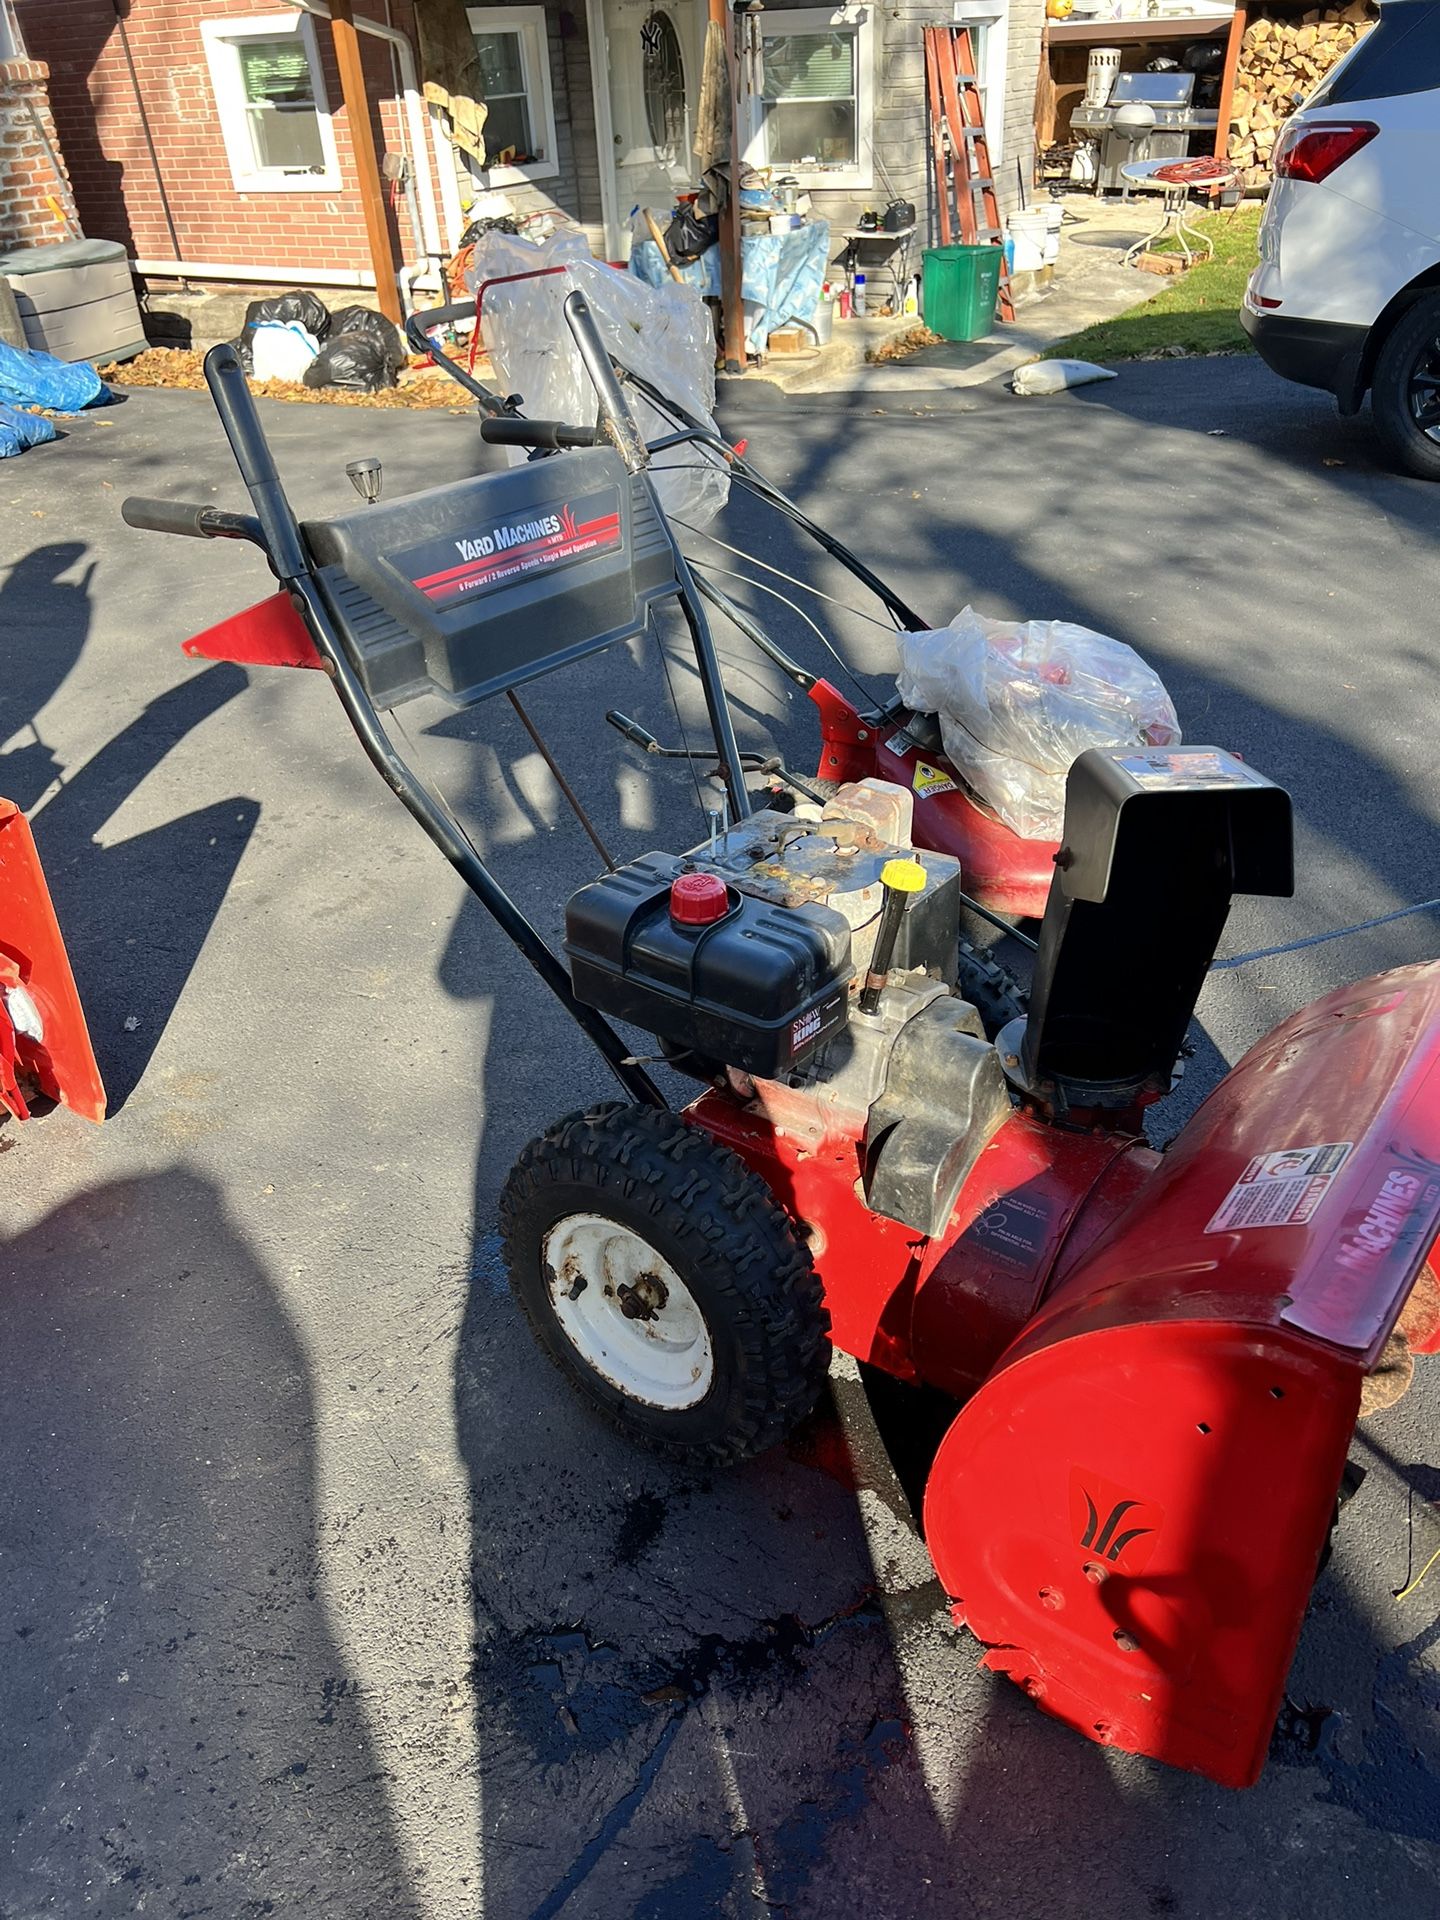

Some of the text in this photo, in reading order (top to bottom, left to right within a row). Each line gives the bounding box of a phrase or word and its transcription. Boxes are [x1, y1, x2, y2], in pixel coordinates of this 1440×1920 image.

[455, 514, 561, 561] YARD MACHINES
[464, 574, 488, 590] Forward
[491, 572, 496, 580] 2
[496, 565, 520, 579] Reverse
[520, 558, 540, 571] Speeds
[542, 551, 559, 563] Single
[559, 546, 573, 557] Hand
[573, 539, 597, 553] Operation
[924, 781, 954, 794] DANGER
[793, 1016, 821, 1045] KING
[1290, 1180, 1323, 1221] DANGER
[1334, 1170, 1421, 1275] MACHINES
